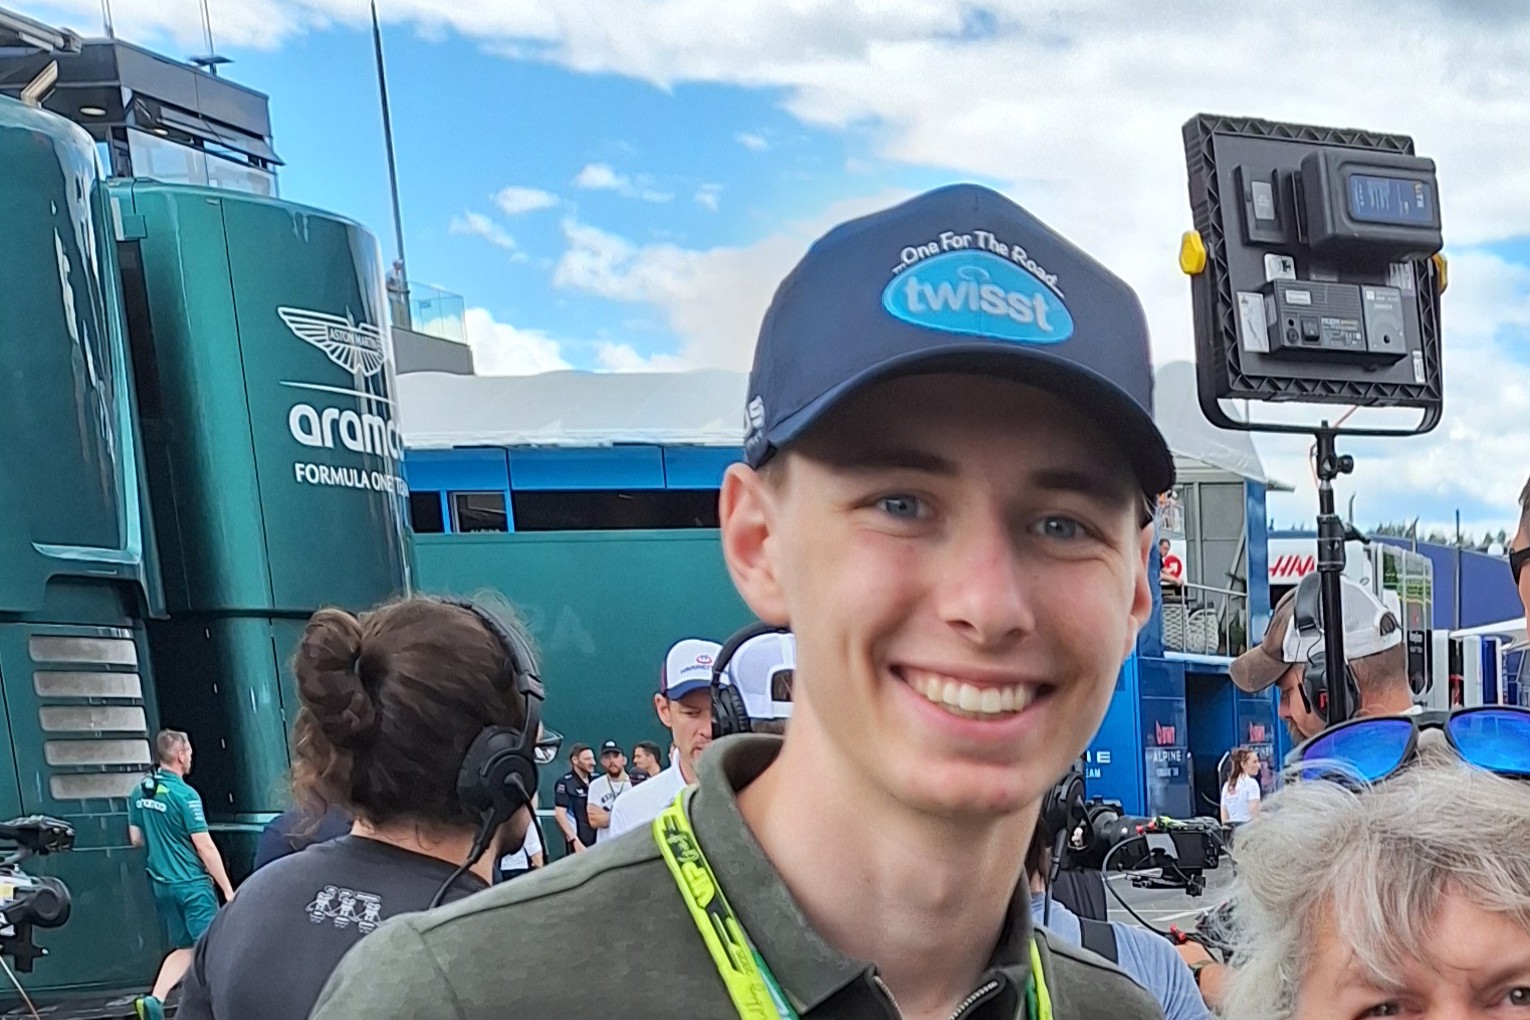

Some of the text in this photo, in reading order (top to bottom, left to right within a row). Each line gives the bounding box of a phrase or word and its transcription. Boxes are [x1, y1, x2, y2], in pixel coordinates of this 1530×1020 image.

[938, 230, 972, 251] For
[973, 230, 1009, 257] The
[903, 272, 1054, 333] twisst
[330, 327, 355, 344] ASTON
[294, 462, 371, 490] FORMULA
[371, 472, 395, 493] ONE
[1152, 750, 1182, 763] ALPINE
